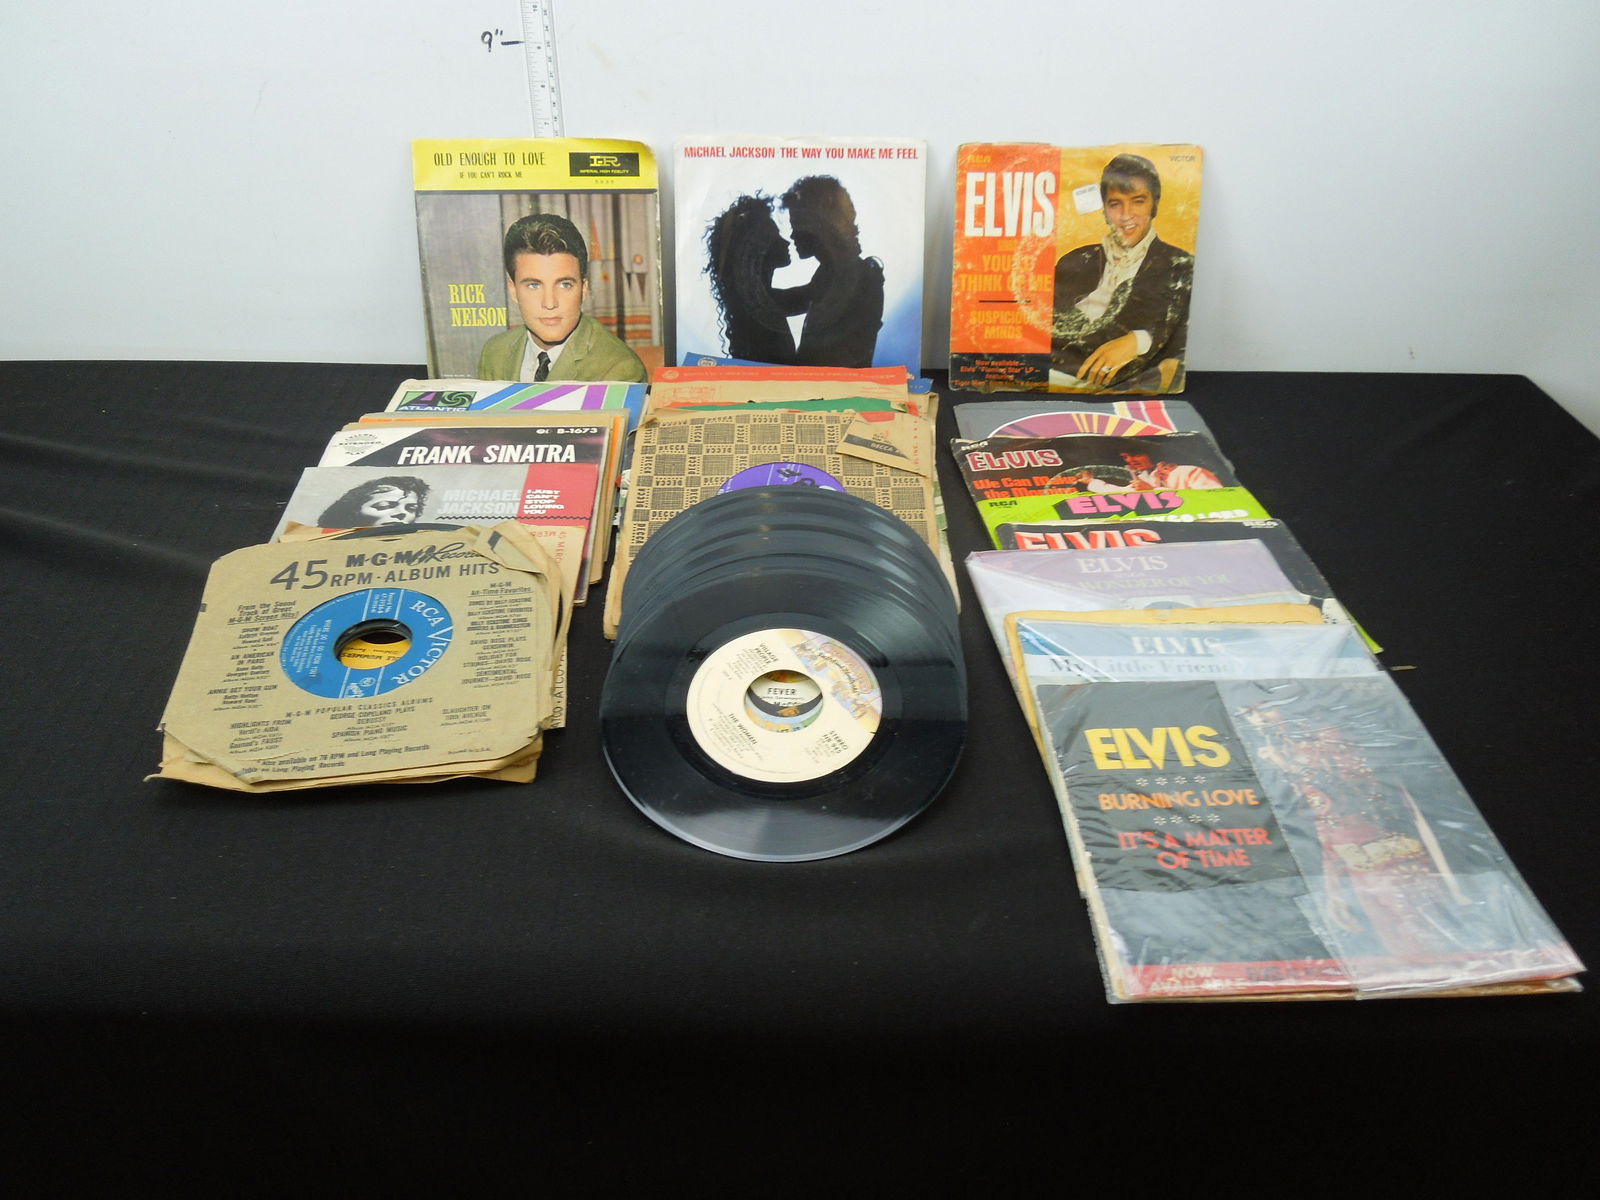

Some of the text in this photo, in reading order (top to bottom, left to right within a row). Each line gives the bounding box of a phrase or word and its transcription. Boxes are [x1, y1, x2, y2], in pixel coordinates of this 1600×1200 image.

[480, 28, 503, 52] 9"
[433, 151, 546, 167] OLD ENOUGH TO LOVE
[684, 146, 918, 160] MICHAEL JACKSON THE WAY YOU MAKE ME FEEL
[515, 171, 523, 179] ME
[965, 170, 1056, 238] ELVIS
[960, 273, 1003, 291] THINK
[448, 284, 486, 304] RICK
[451, 307, 507, 327] NELSON
[984, 325, 1024, 339] MINDS
[397, 444, 576, 465] FRANK SINATRA
[966, 449, 1063, 472] ELVIS
[845, 479, 872, 487] DECCA
[973, 475, 1078, 490] We Can Make
[443, 488, 520, 501] MICHAEL
[984, 489, 1010, 499] the
[1066, 491, 1184, 515] ELVIS
[437, 502, 519, 515] JACKSON
[1013, 528, 1161, 550] ELVIS
[1075, 555, 1168, 574] ELVIS
[270, 559, 500, 590] 45 RPM ALBUM HITS
[391, 600, 454, 685] RCA VICTOR
[1131, 634, 1225, 655] ELVIS
[1098, 658, 1156, 674] Little
[1160, 658, 1236, 674] Friend
[767, 687, 797, 696] FEVER
[315, 705, 353, 714] POPULAR
[357, 701, 397, 711] CLASSICS
[1083, 725, 1231, 770] ELVIS
[1098, 789, 1261, 811] BURNING LOVE
[1118, 827, 1273, 850] IT'S A MATTER
[1156, 849, 1252, 870] OF TIME
[1172, 966, 1215, 979] NOW
